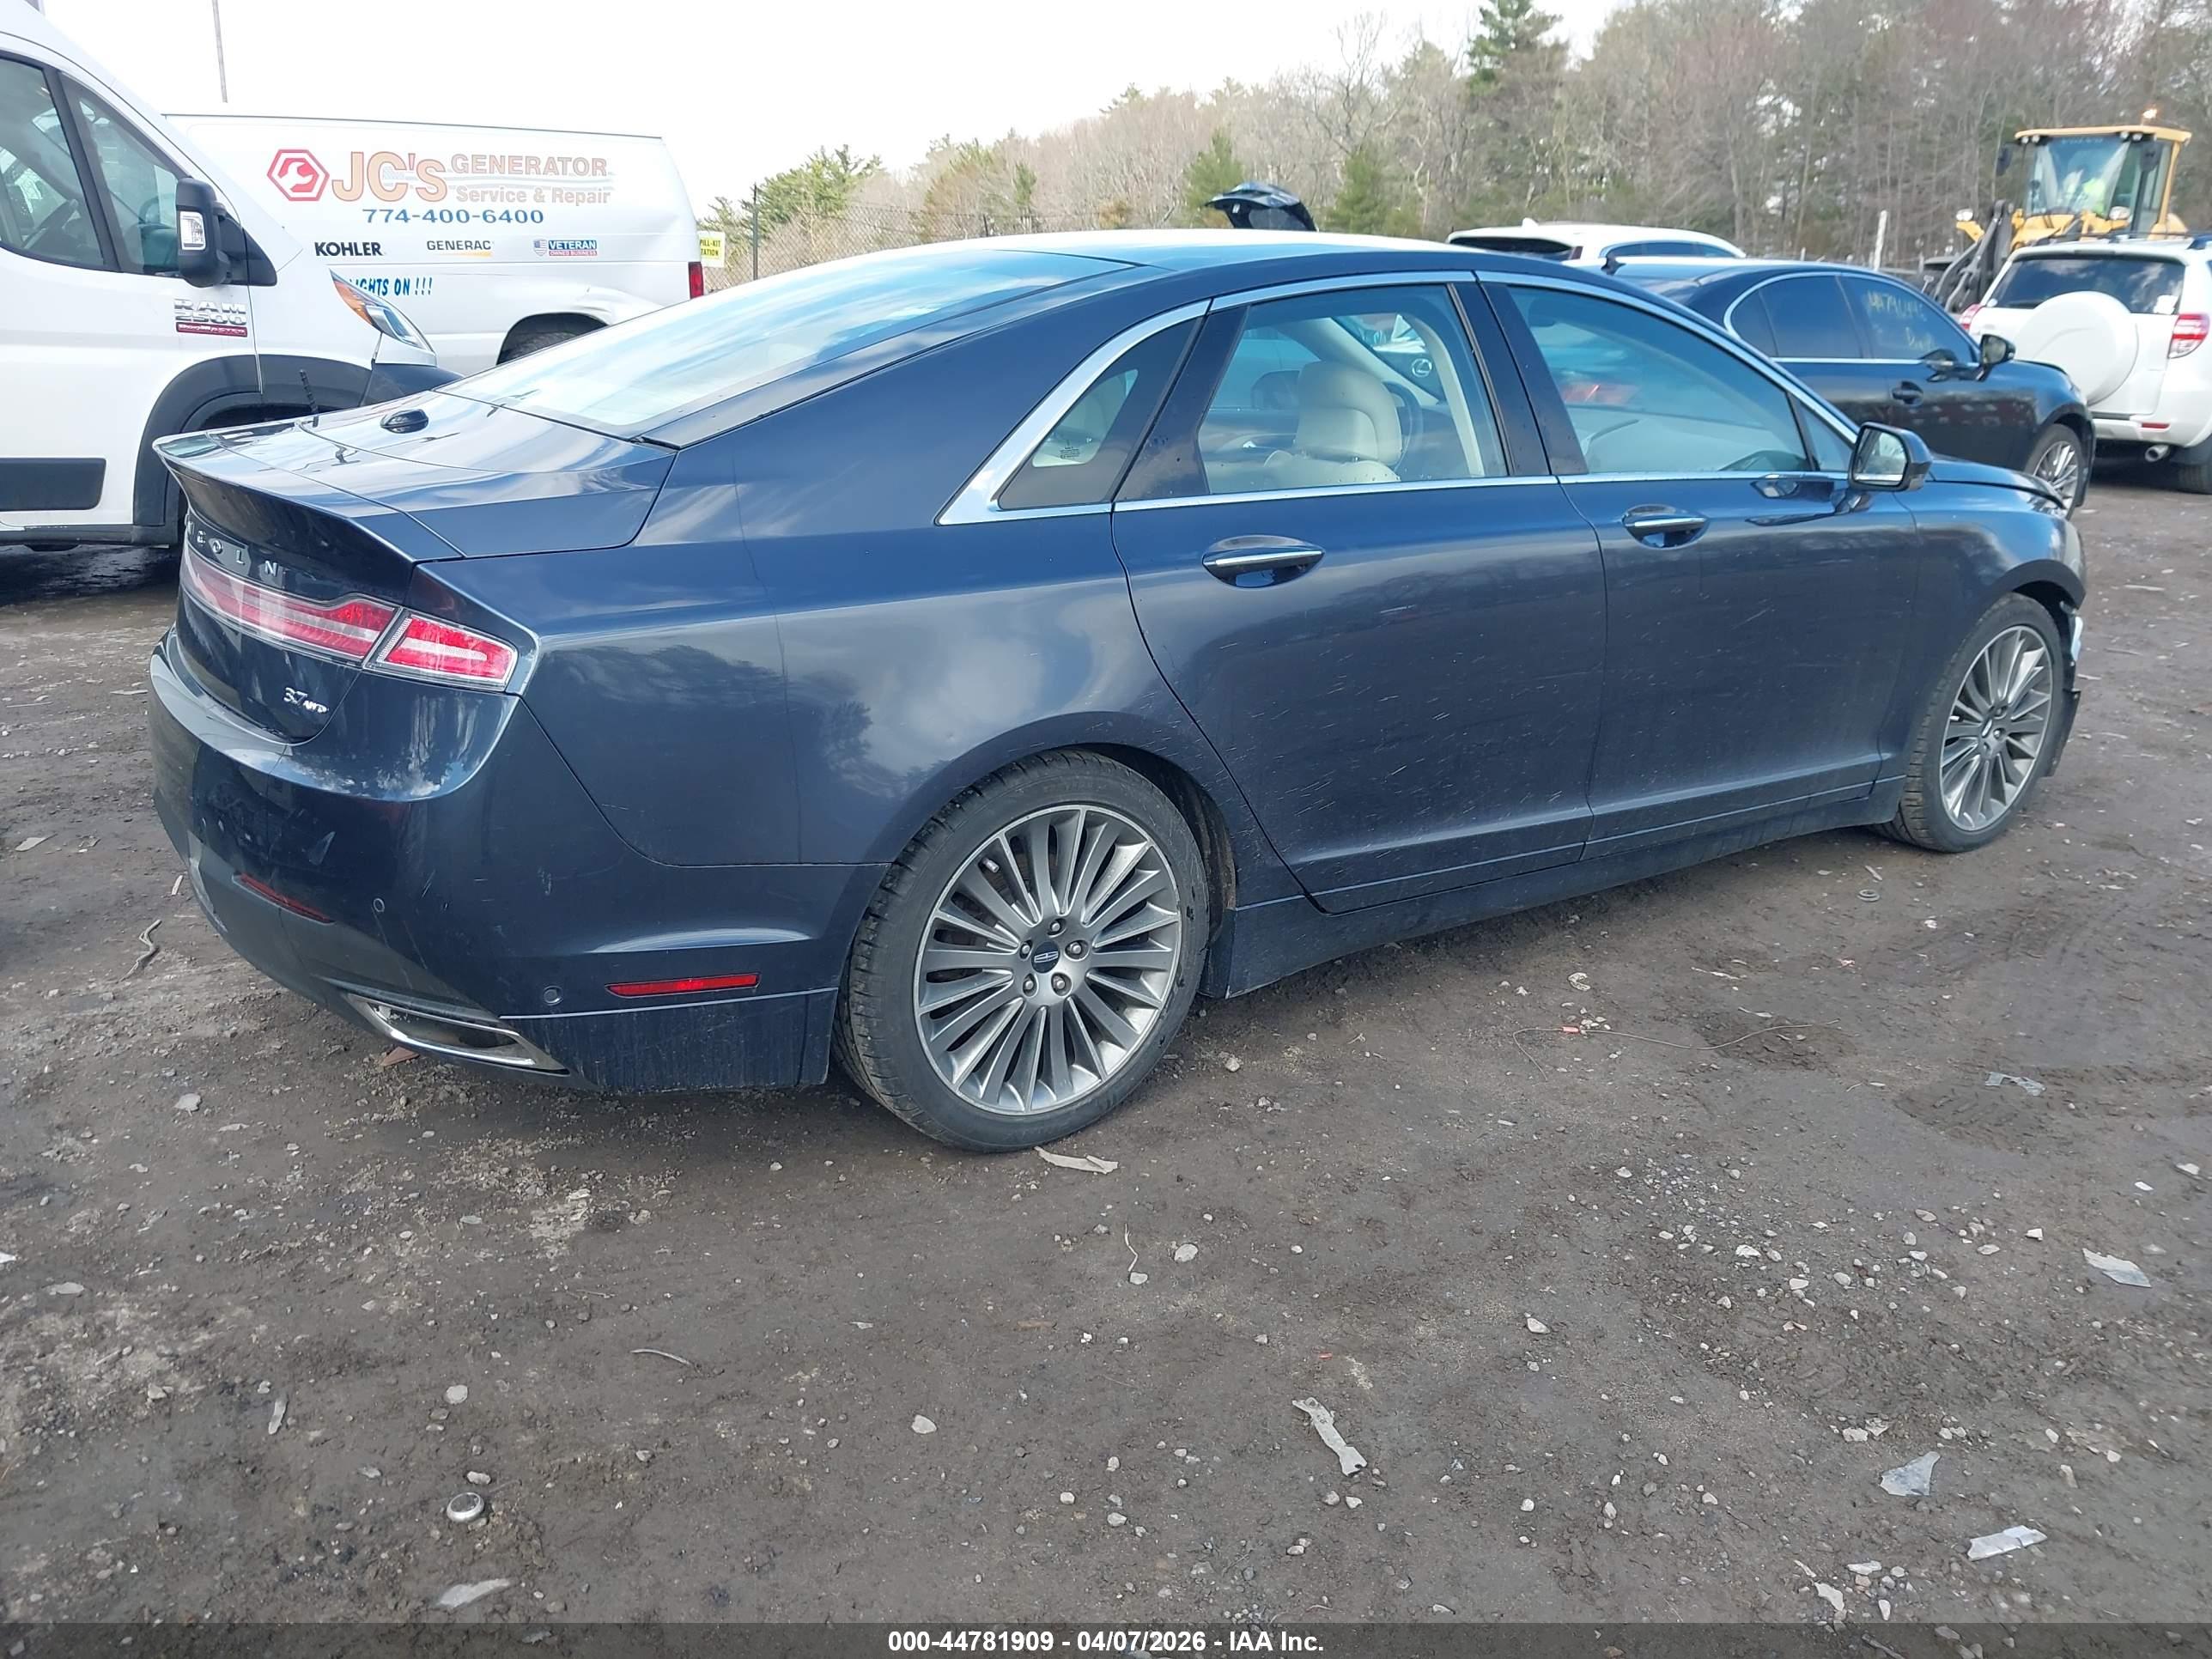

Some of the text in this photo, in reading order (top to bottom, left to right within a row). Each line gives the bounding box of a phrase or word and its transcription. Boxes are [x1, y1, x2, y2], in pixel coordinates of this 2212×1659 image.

[451, 154, 607, 176] GENERATOR
[331, 151, 447, 202] JC's
[456, 185, 611, 206] Service & Repair
[362, 209, 544, 224] 774-400-6400
[314, 241, 383, 257] KOHLER
[427, 240, 492, 251] GENERAC
[549, 240, 596, 249] VETERAN
[394, 278, 410, 295] ON
[174, 298, 246, 314] RAM
[174, 310, 246, 325] 2500
